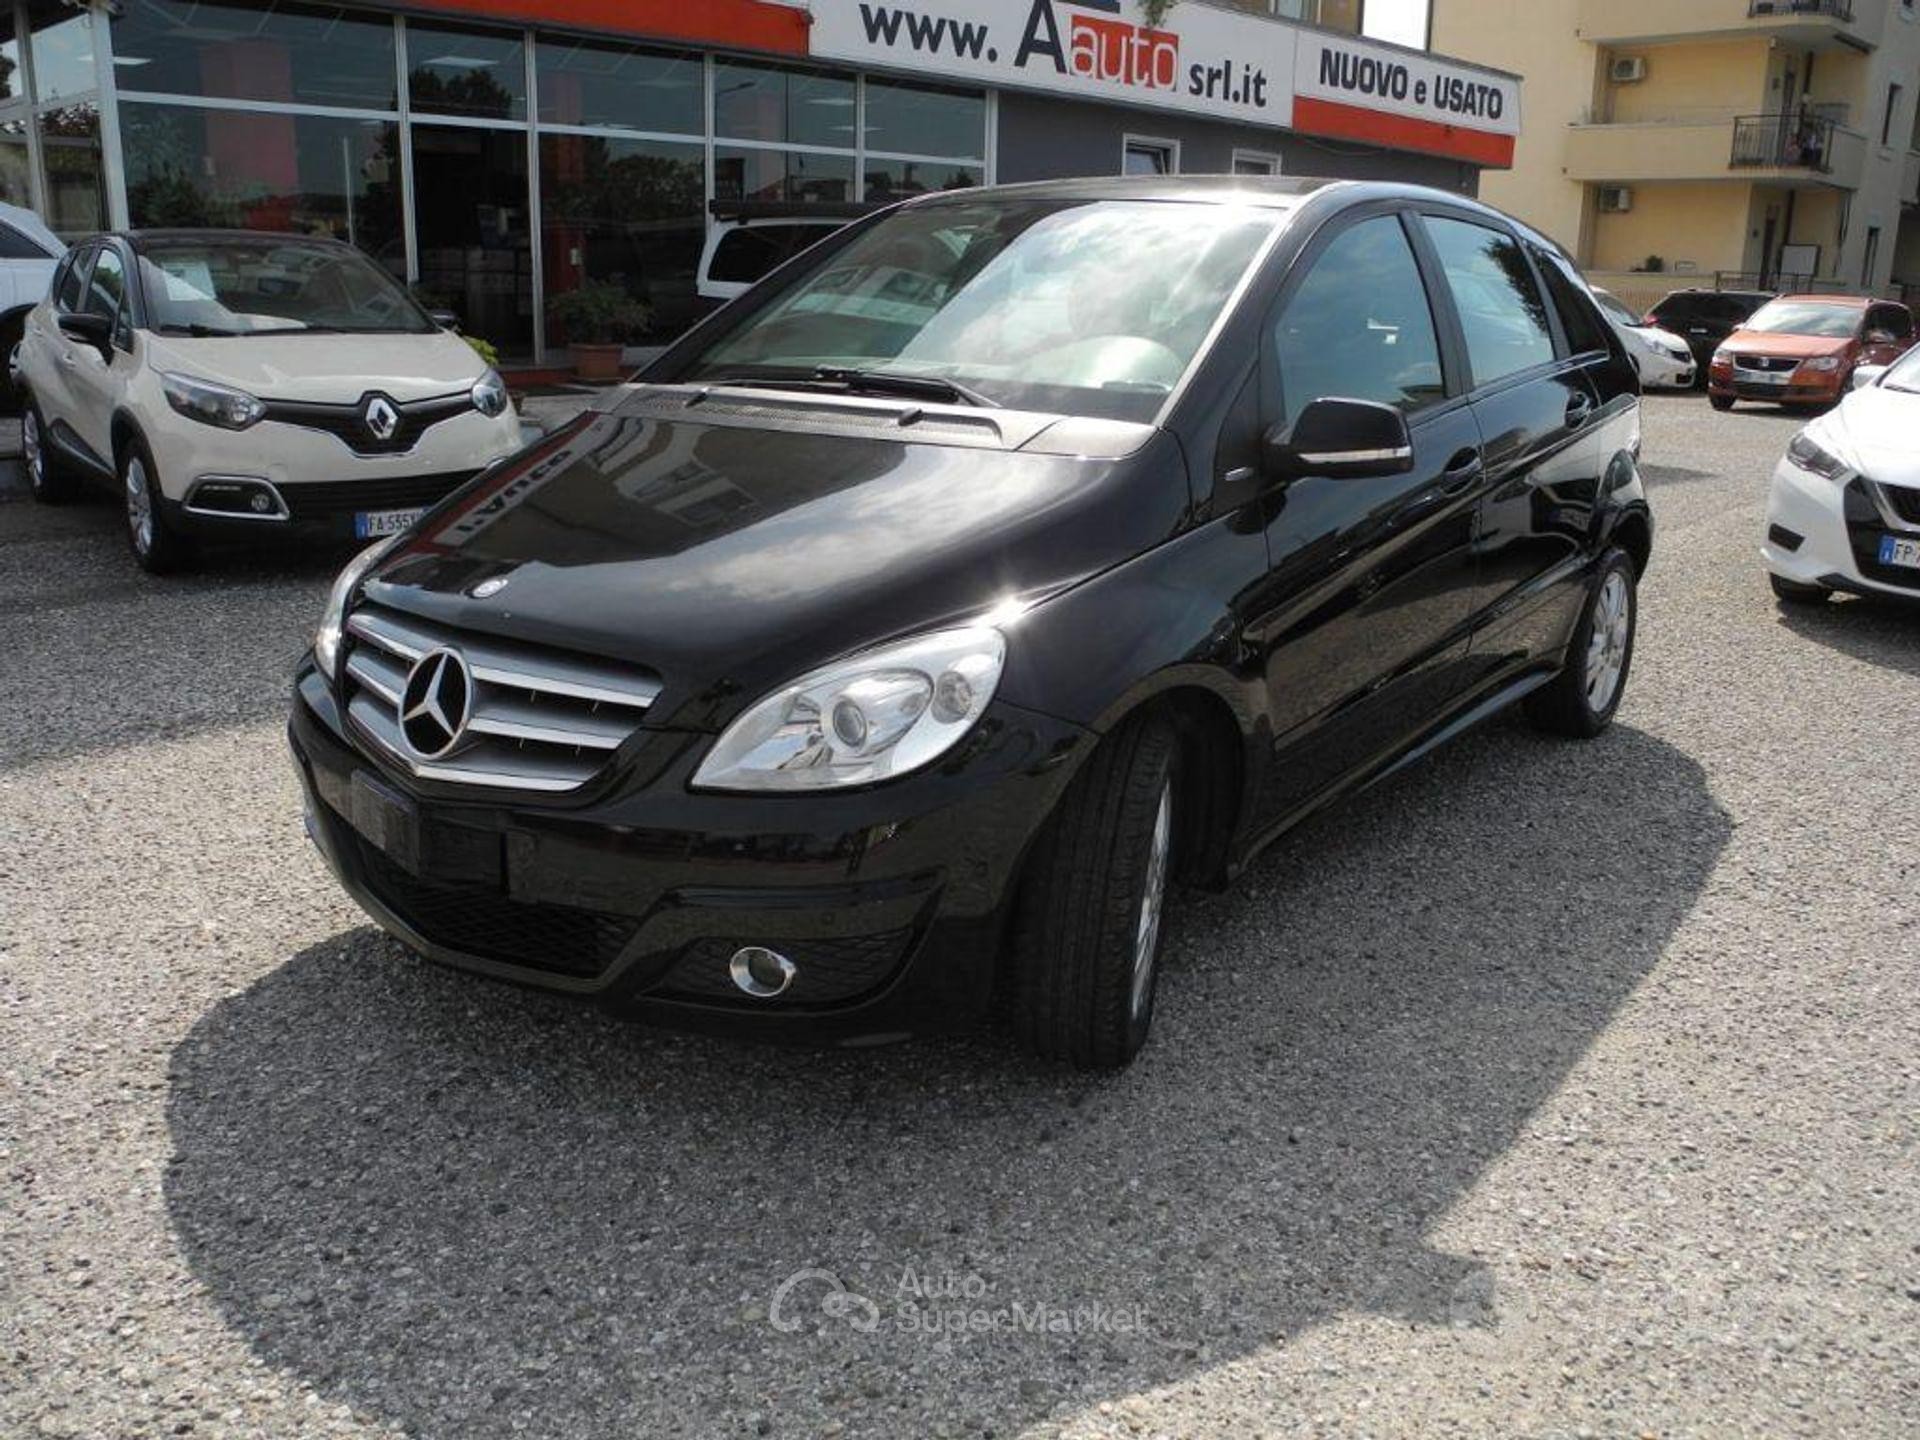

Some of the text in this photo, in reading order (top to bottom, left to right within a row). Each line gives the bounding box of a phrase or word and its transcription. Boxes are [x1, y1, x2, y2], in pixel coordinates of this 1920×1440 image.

[859, 3, 998, 62] www.
[1189, 60, 1267, 107] srl.it
[1320, 48, 1503, 119] NUOVO e USATO
